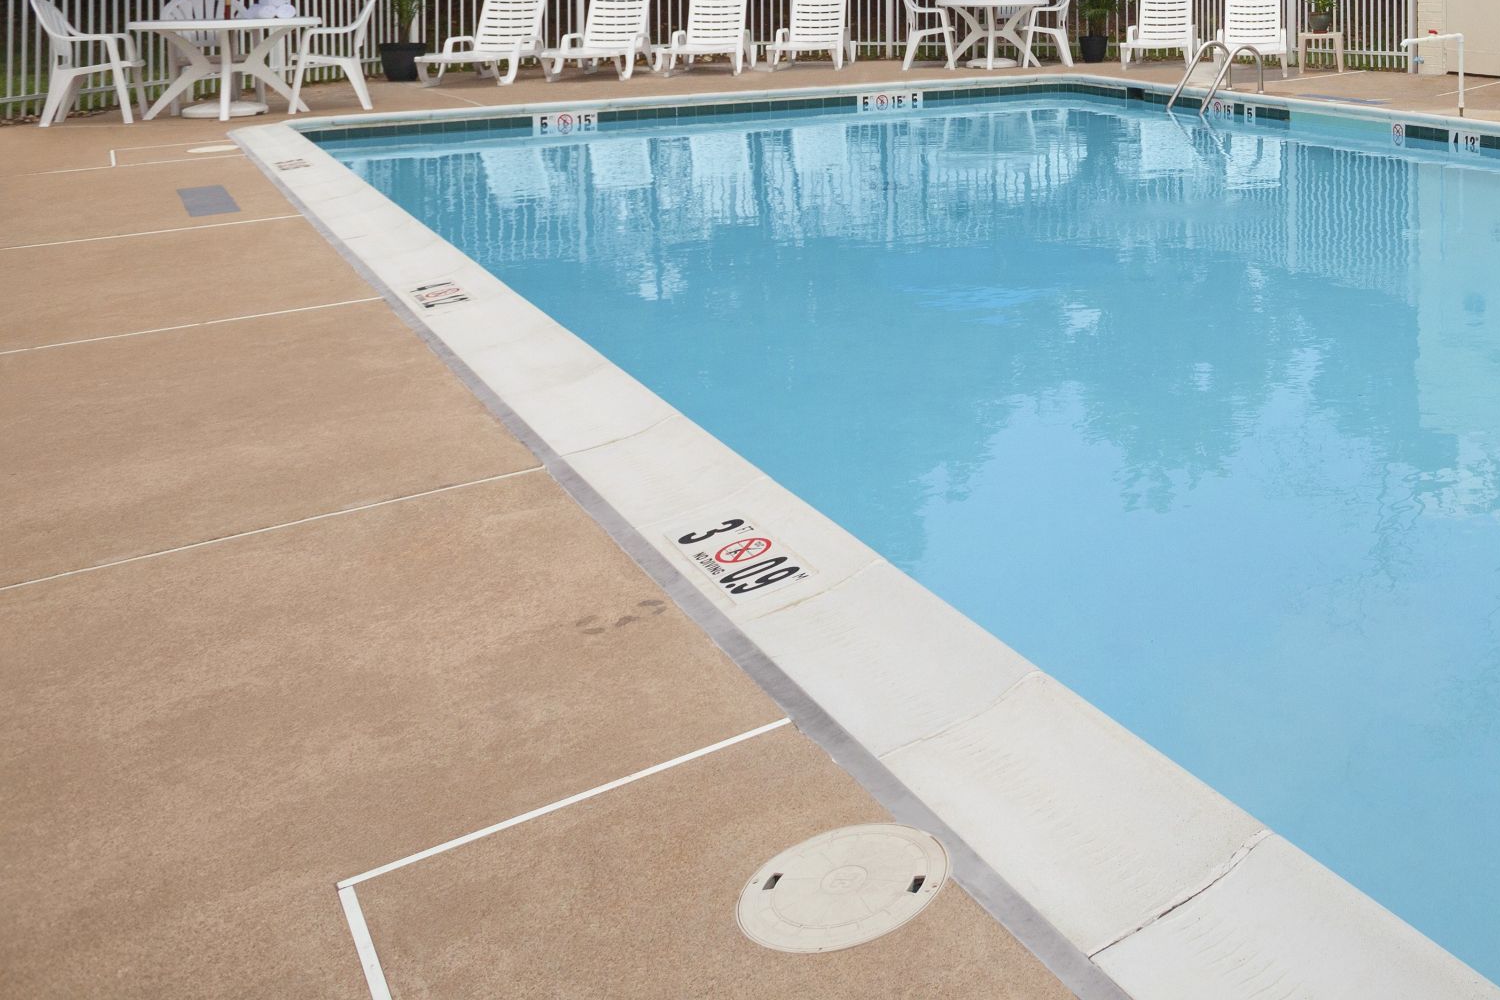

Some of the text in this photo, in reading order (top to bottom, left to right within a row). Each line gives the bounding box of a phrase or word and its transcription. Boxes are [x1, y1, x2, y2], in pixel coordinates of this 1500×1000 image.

[678, 518, 745, 545] 3
[693, 551, 725, 576] NO DIVING
[719, 556, 800, 595] 0.9
